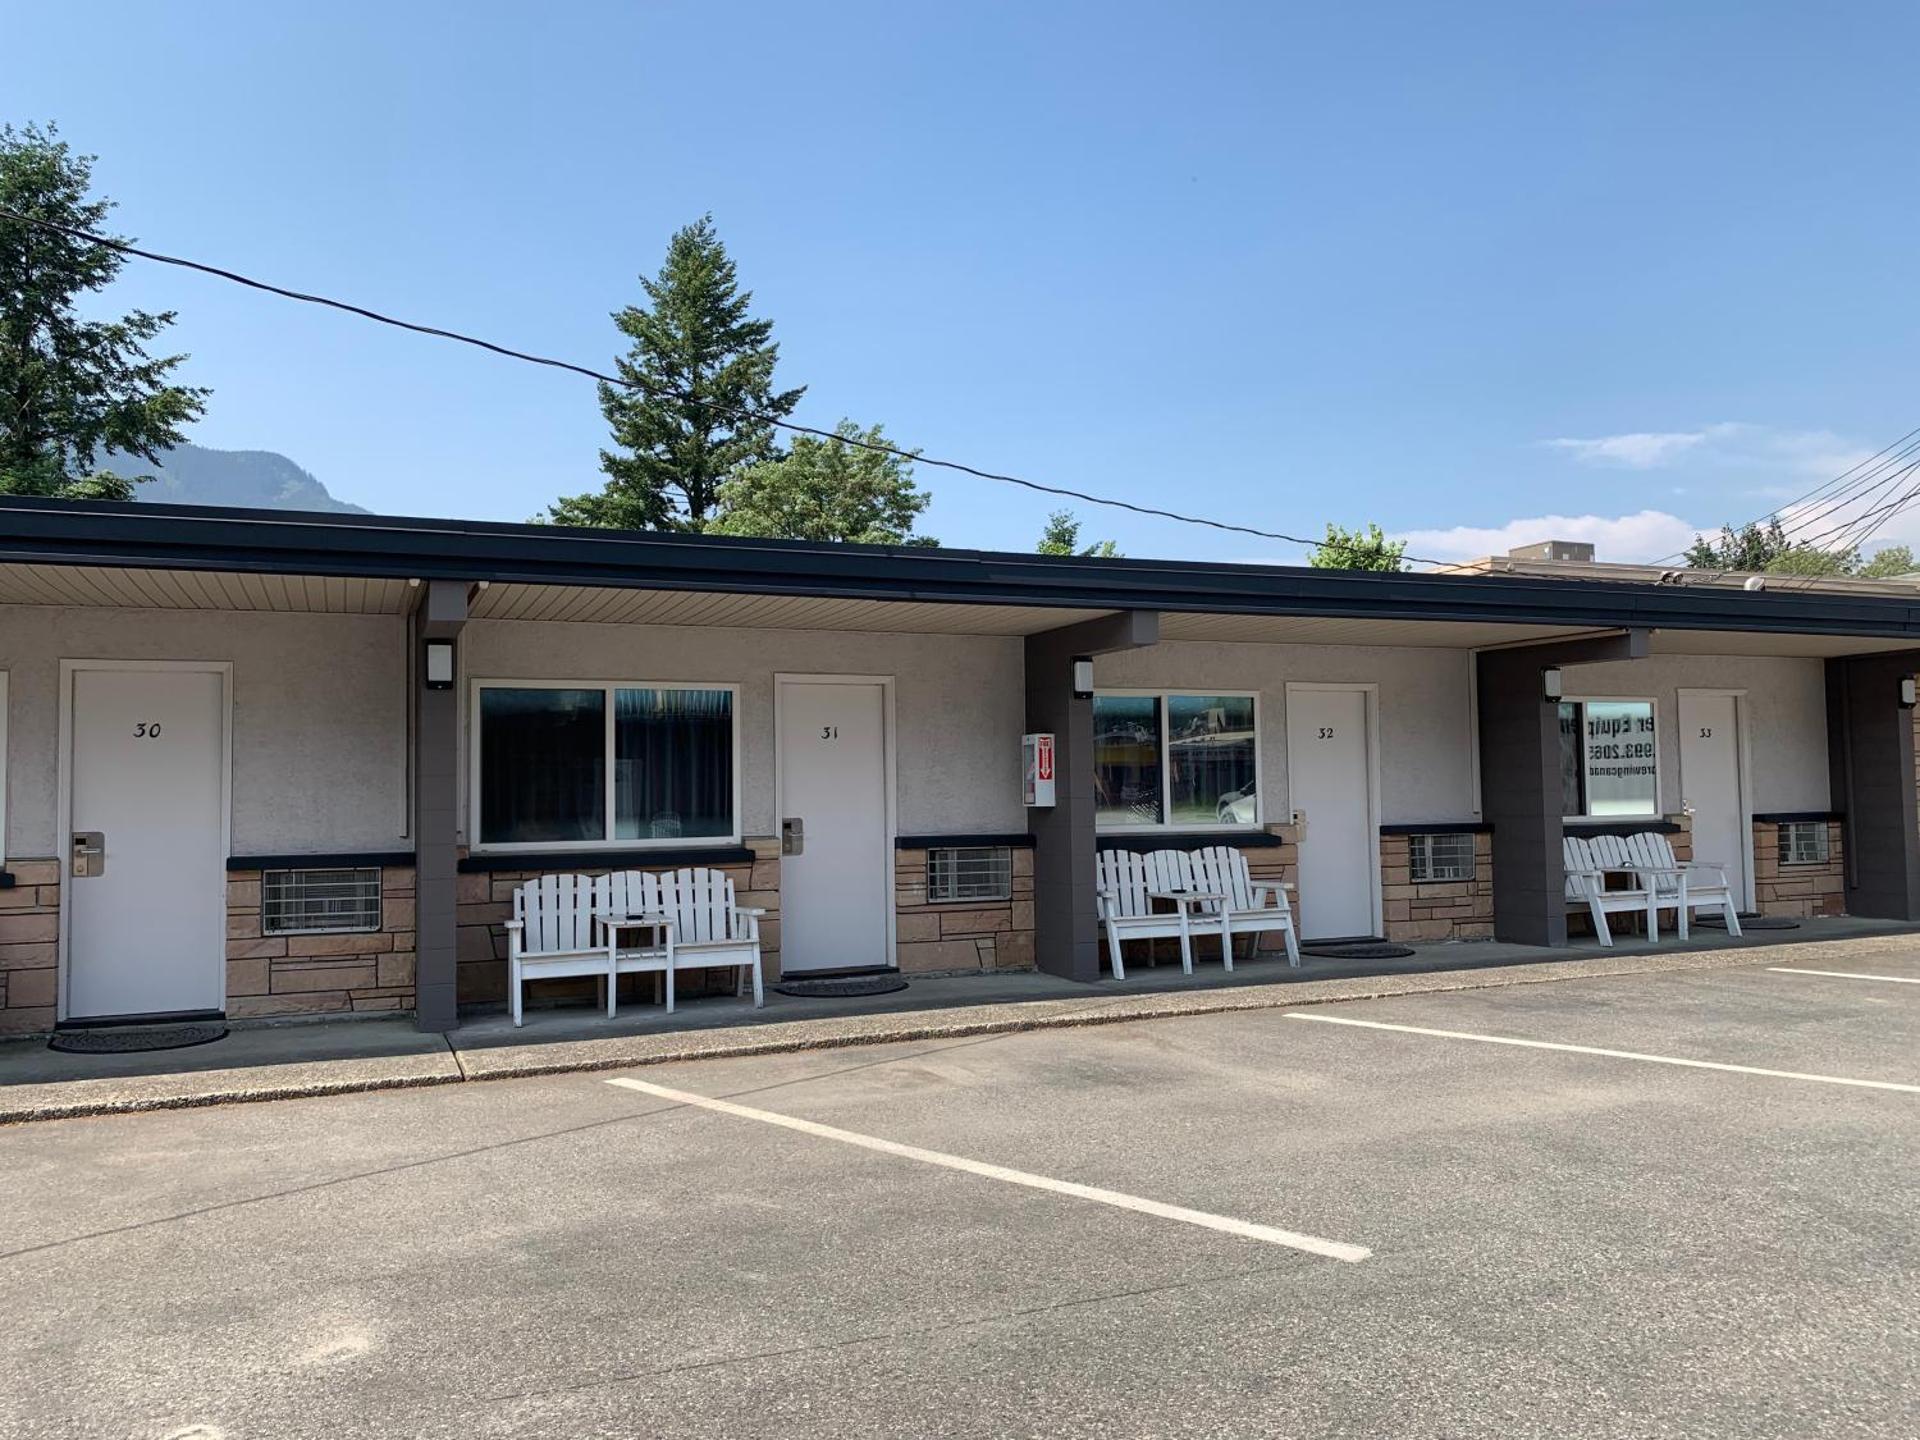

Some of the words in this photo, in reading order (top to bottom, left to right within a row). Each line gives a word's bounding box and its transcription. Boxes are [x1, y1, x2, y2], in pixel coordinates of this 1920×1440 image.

[133, 722, 162, 738] 30
[820, 726, 838, 740] 31
[1318, 727, 1334, 740] 32
[1699, 727, 1712, 738] 33
